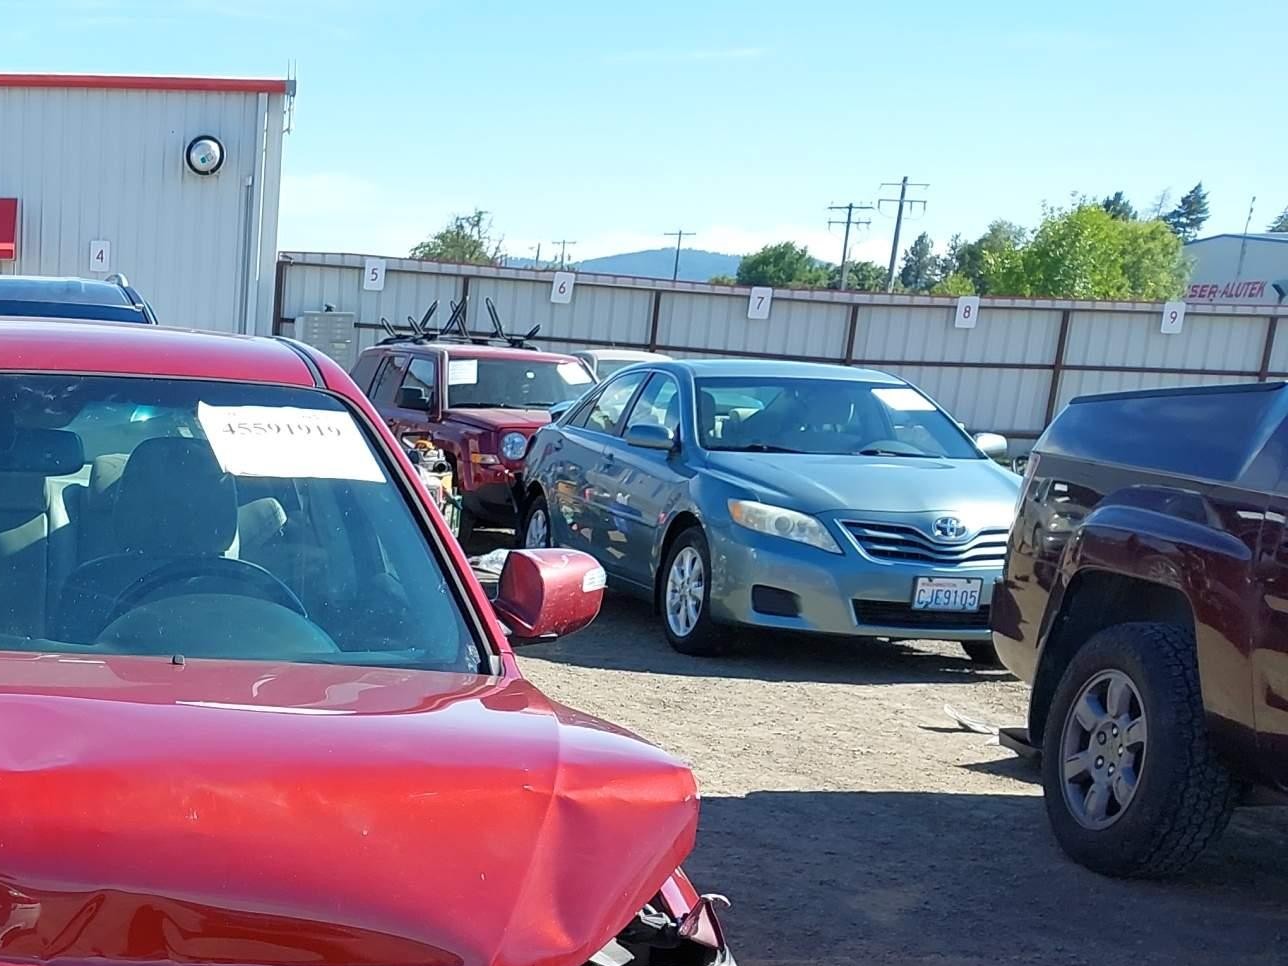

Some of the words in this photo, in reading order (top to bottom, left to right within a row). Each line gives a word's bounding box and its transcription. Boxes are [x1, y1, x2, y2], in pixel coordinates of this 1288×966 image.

[95, 249, 104, 263] 4
[370, 267, 379, 281] 5
[558, 280, 566, 294] 6
[756, 296, 765, 310] 7
[962, 305, 972, 319] 8
[1169, 310, 1178, 324] 9
[222, 422, 342, 437] 45591919
[917, 588, 978, 607] CJE9105
